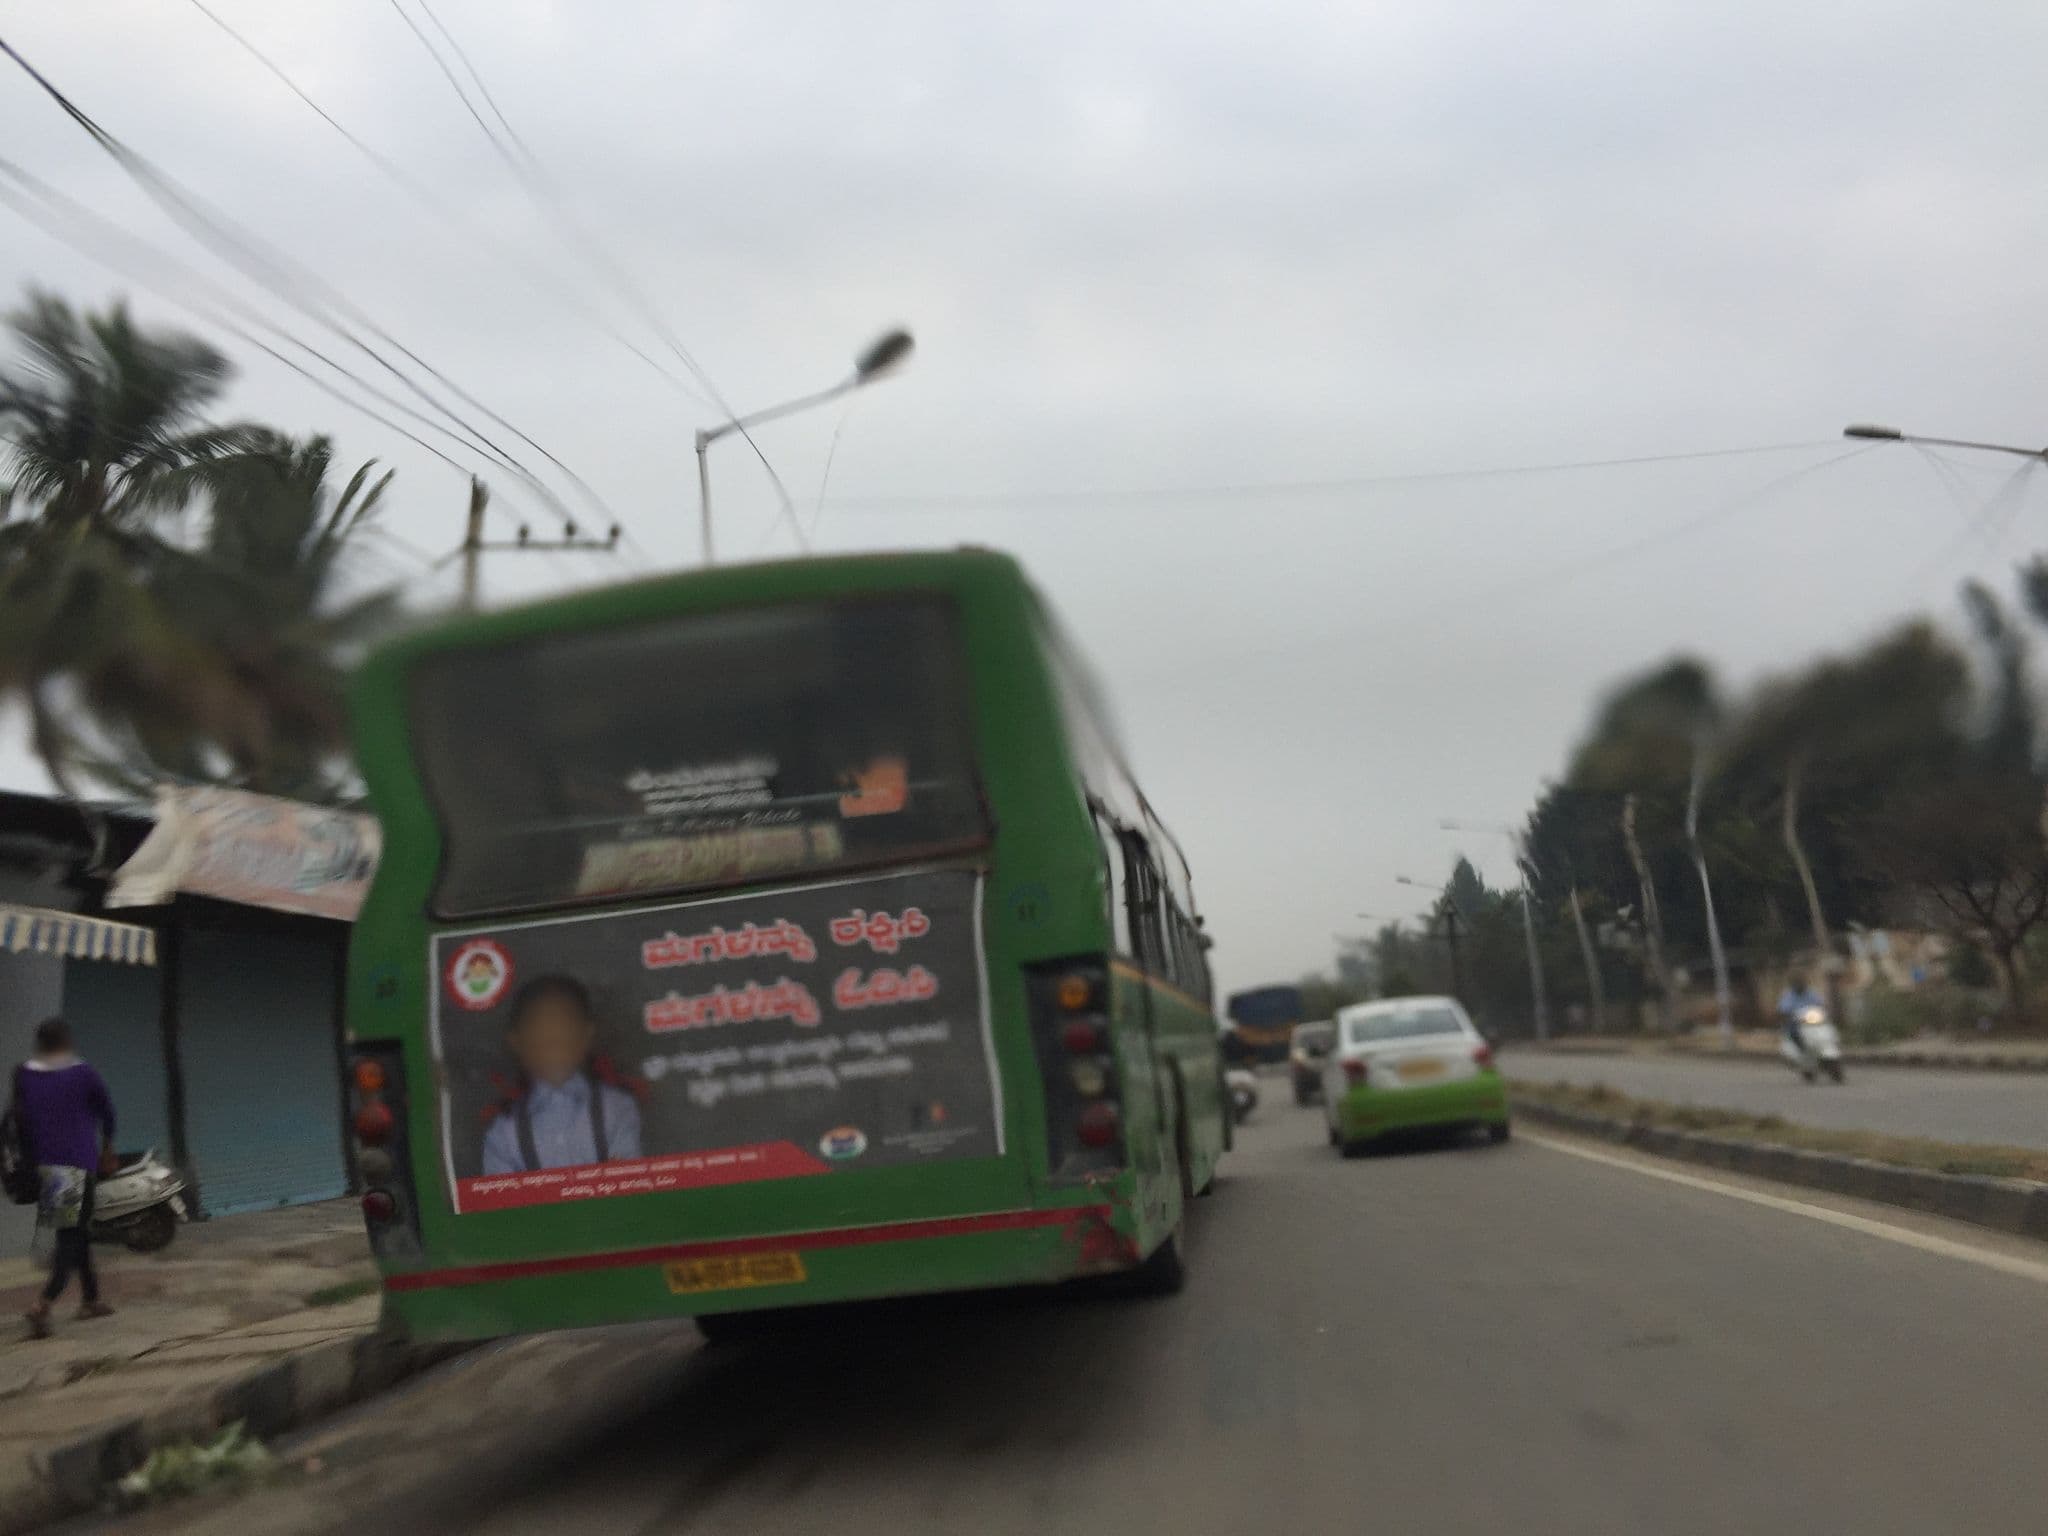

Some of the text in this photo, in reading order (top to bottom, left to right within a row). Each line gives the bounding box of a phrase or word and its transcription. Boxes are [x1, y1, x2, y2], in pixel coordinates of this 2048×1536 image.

[642, 905, 931, 970] ಮಗಳನ್ನು ರಕ್ಷಿಸಿ
[644, 976, 822, 1034] ಮಗಳನ್ನು
